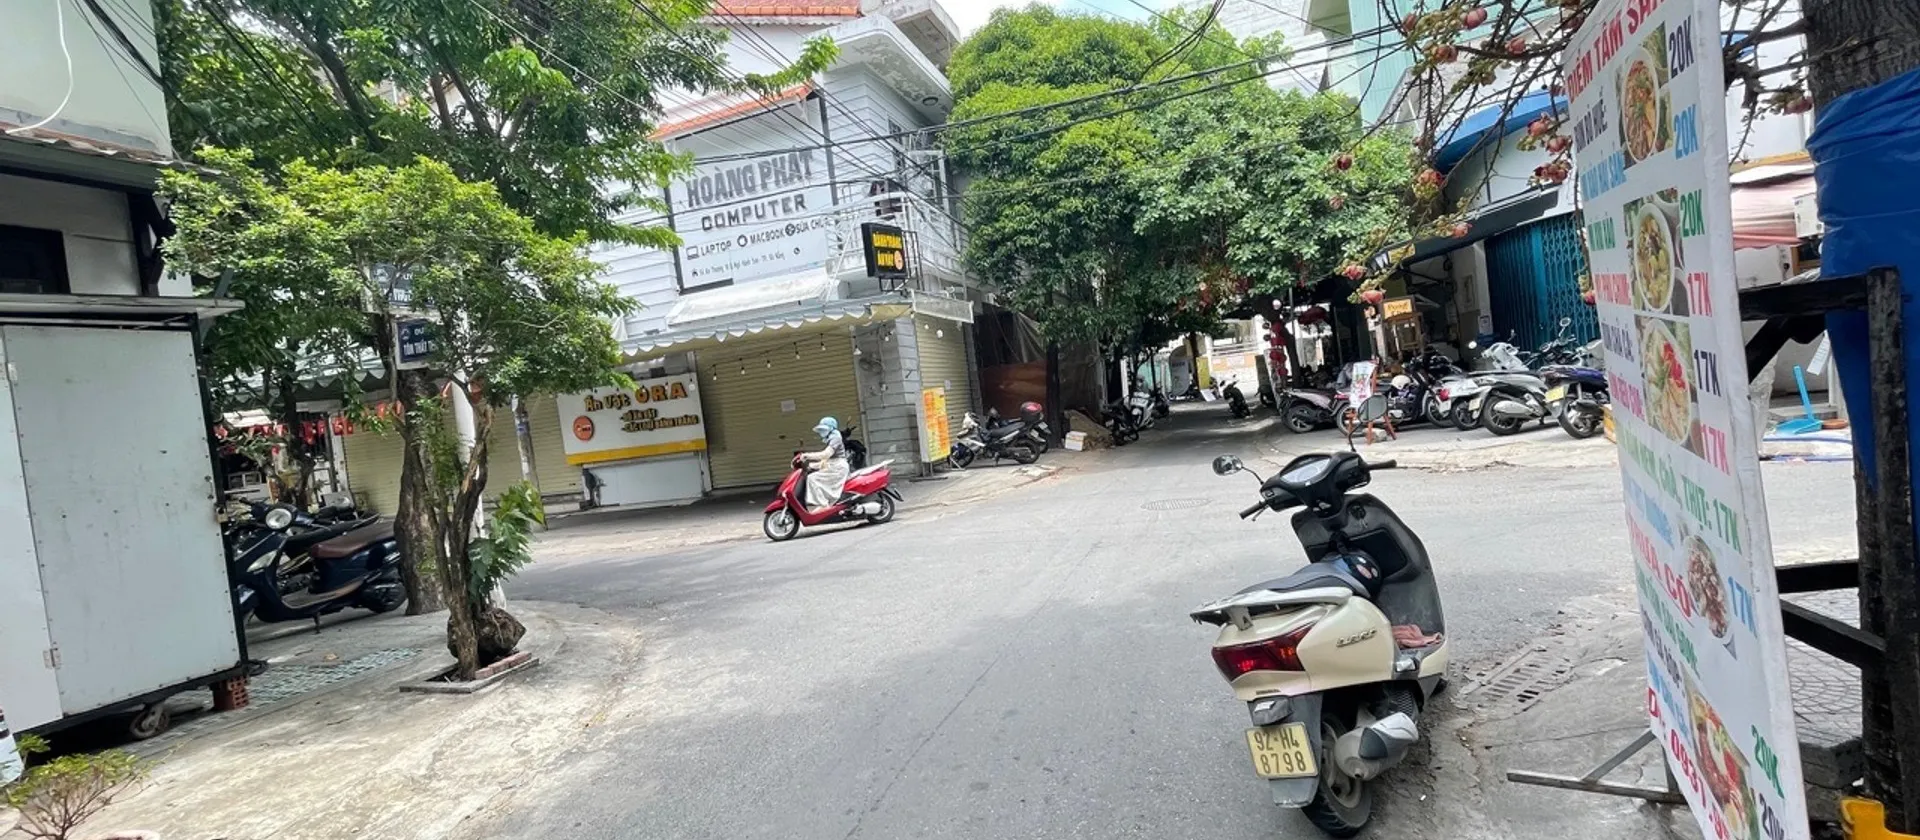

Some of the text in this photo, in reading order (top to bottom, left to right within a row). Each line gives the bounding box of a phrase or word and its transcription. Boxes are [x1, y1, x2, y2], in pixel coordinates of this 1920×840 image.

[1668, 15, 1694, 79] 20K
[1673, 104, 1699, 160] 20K
[686, 164, 756, 208] HOÀNG
[701, 194, 807, 231] COMPUTER
[1680, 189, 1705, 238] 20K
[701, 240, 732, 256] LAPTOP
[750, 229, 785, 245] MACBOOK
[1688, 272, 1712, 317] 17K
[584, 394, 604, 412] Ăn
[635, 382, 688, 404] ORA
[1693, 349, 1721, 397] 17K
[1701, 424, 1730, 476] 17K
[1681, 474, 1712, 531] THỊT:
[1713, 498, 1742, 556] 17K
[1728, 576, 1758, 639] 17K
[1260, 751, 1306, 775] 8798
[1752, 724, 1785, 800] 20K
